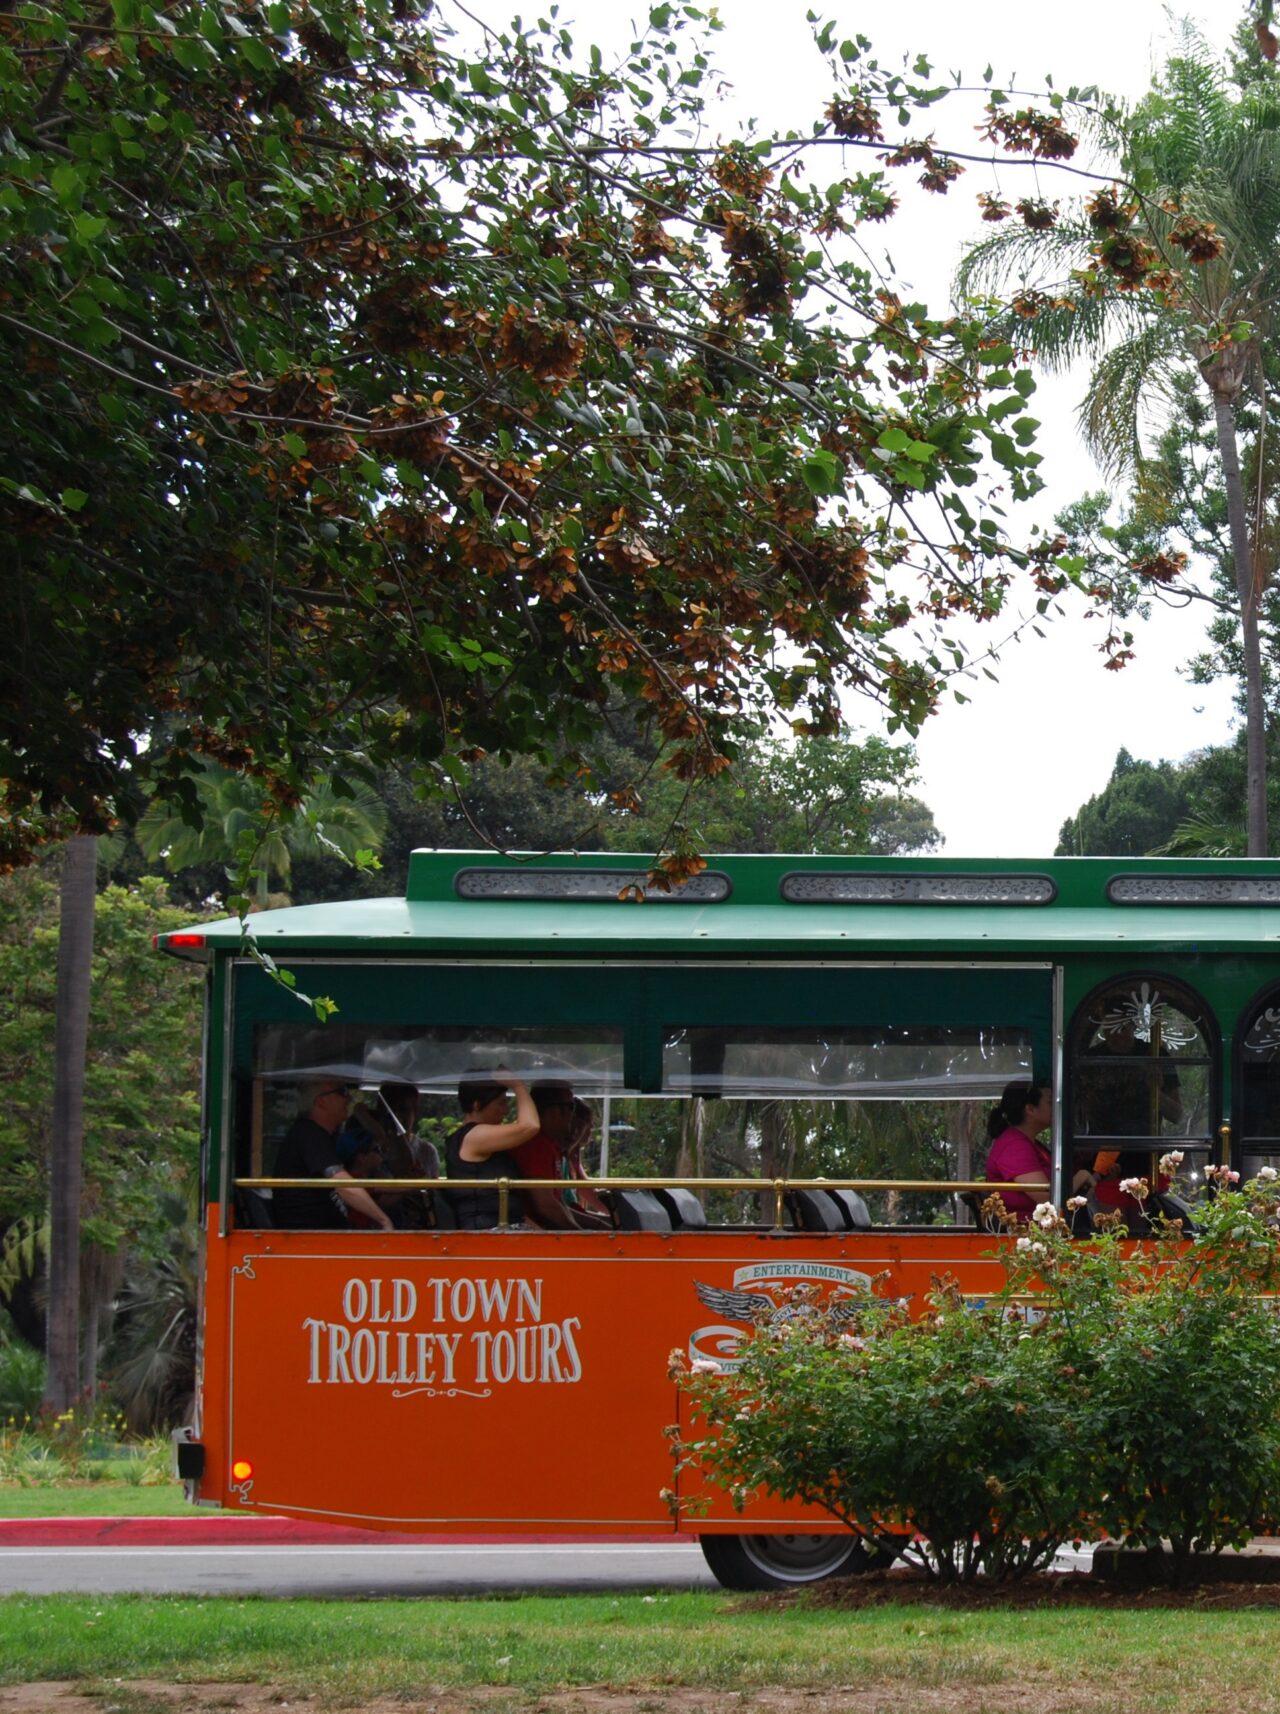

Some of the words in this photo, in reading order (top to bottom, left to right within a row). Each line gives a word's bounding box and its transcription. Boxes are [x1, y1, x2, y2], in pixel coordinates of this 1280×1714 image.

[753, 1264, 851, 1281] ENTERTAINMENT
[343, 1278, 417, 1322] OLD
[427, 1278, 543, 1322] TOWN
[302, 1317, 463, 1384] TROLLEY
[471, 1316, 582, 1383] TOURS
